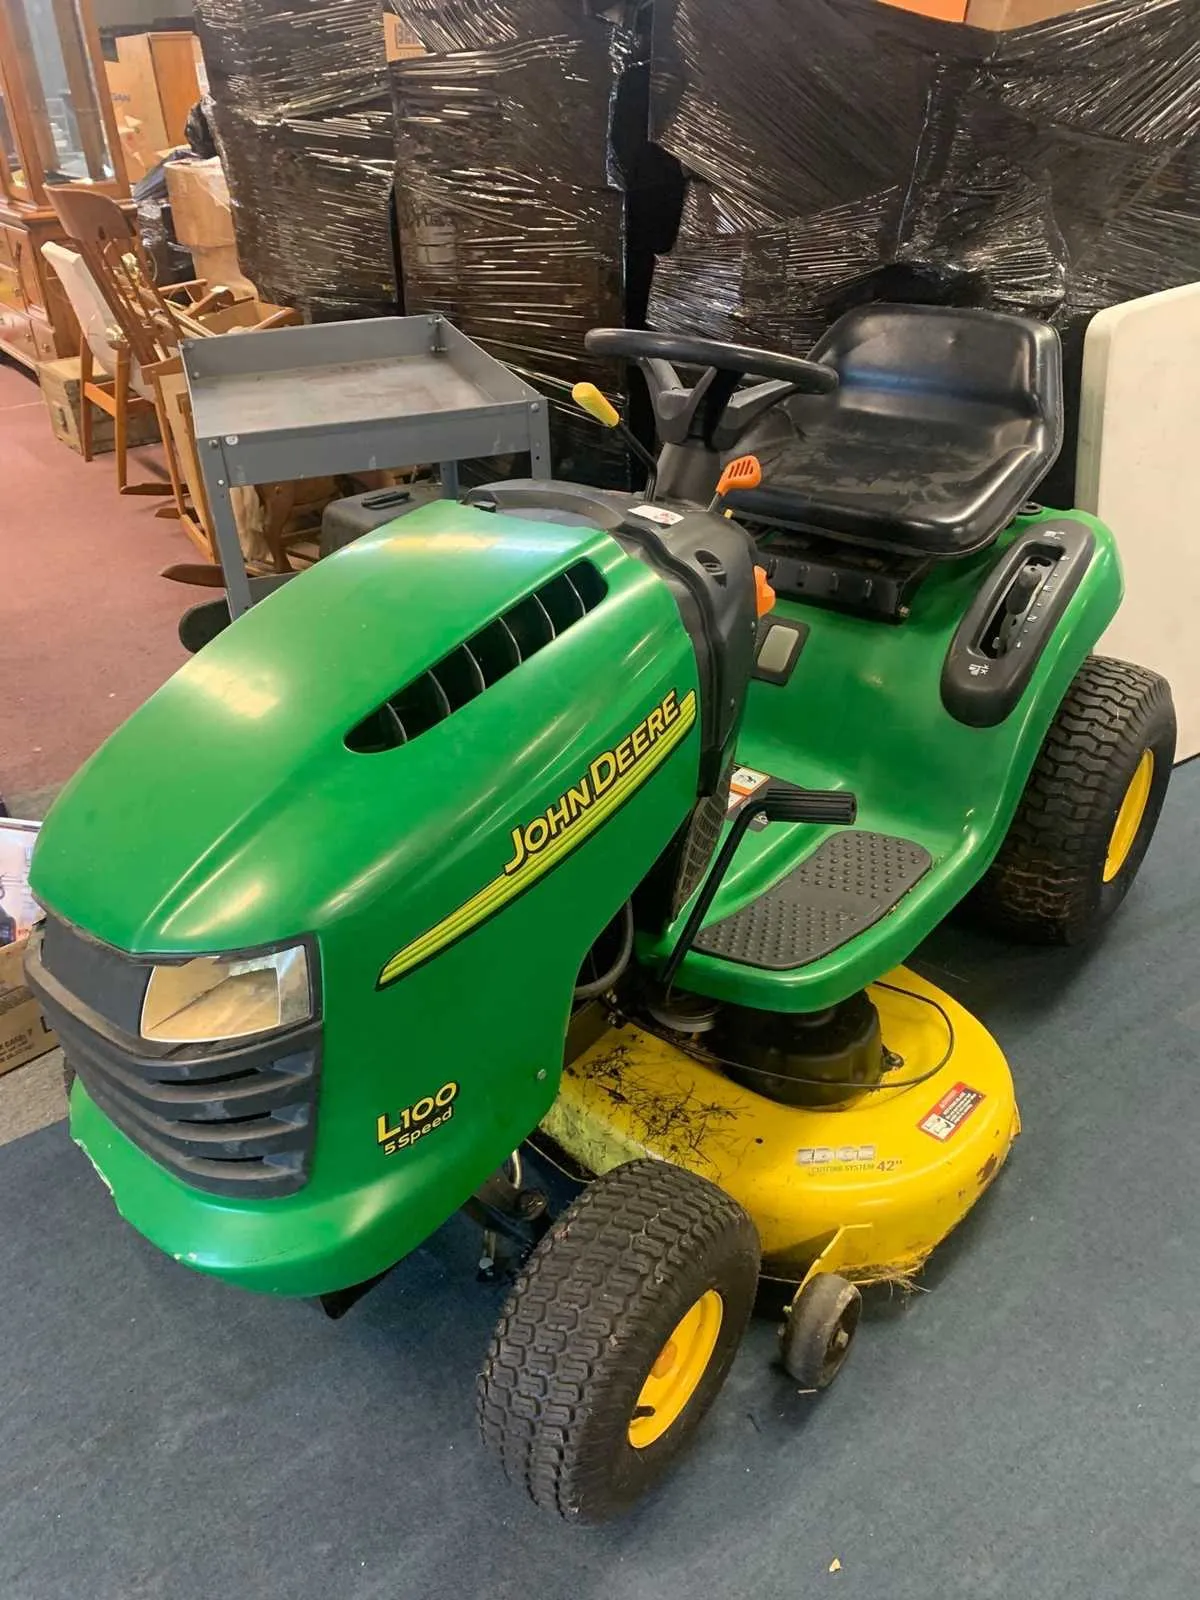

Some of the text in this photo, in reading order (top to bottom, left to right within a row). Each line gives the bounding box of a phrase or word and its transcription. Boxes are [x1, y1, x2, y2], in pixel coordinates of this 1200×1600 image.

[504, 688, 681, 874] JOHN DEERE
[377, 1082, 457, 1143] L100
[876, 1159, 903, 1172] 42"
